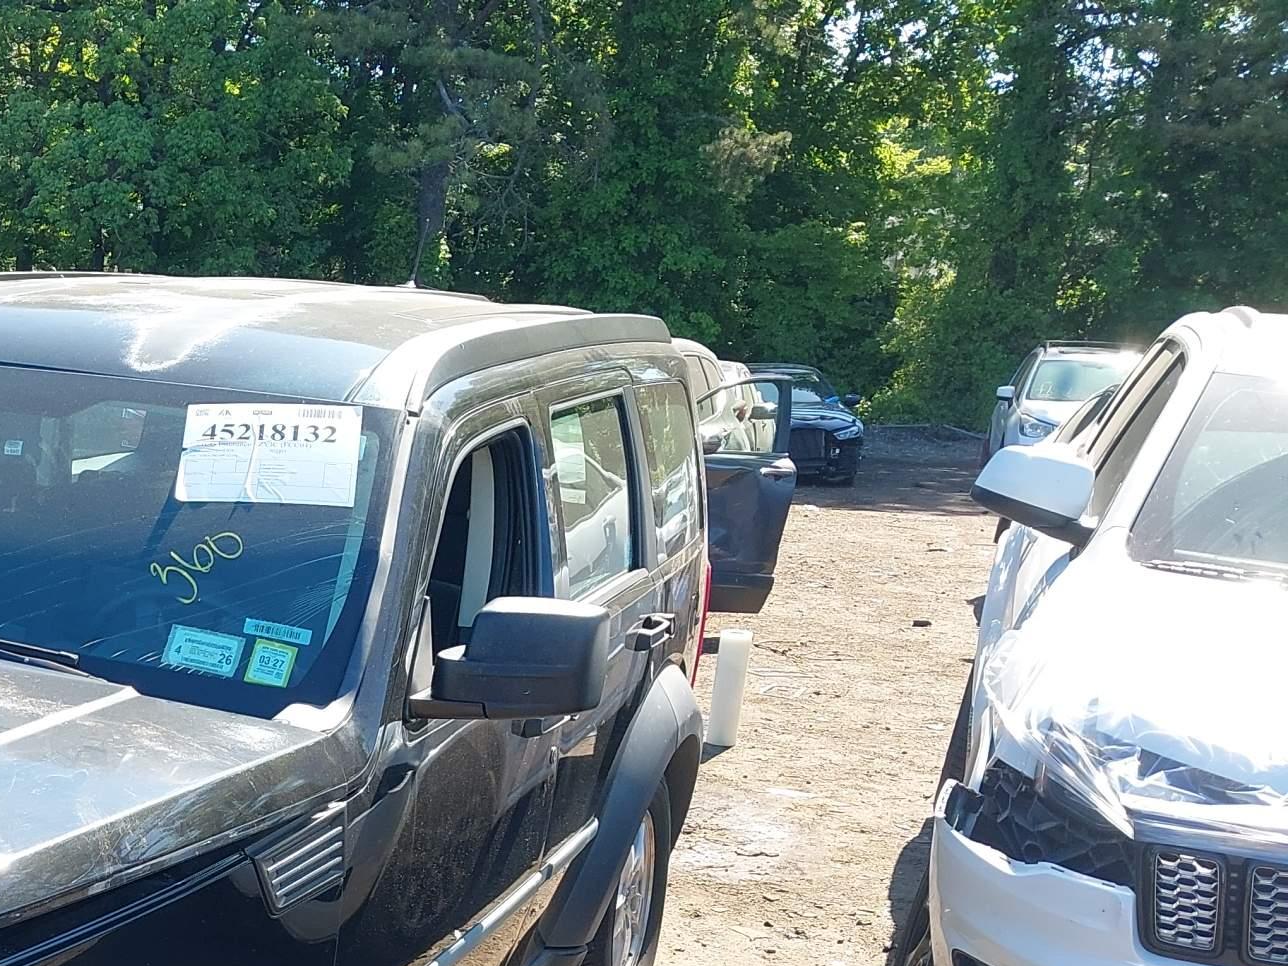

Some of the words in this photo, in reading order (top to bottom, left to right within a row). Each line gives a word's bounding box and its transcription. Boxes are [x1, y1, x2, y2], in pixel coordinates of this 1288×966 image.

[201, 423, 337, 443] 45218132
[150, 532, 243, 604] 360
[217, 653, 233, 666] 26
